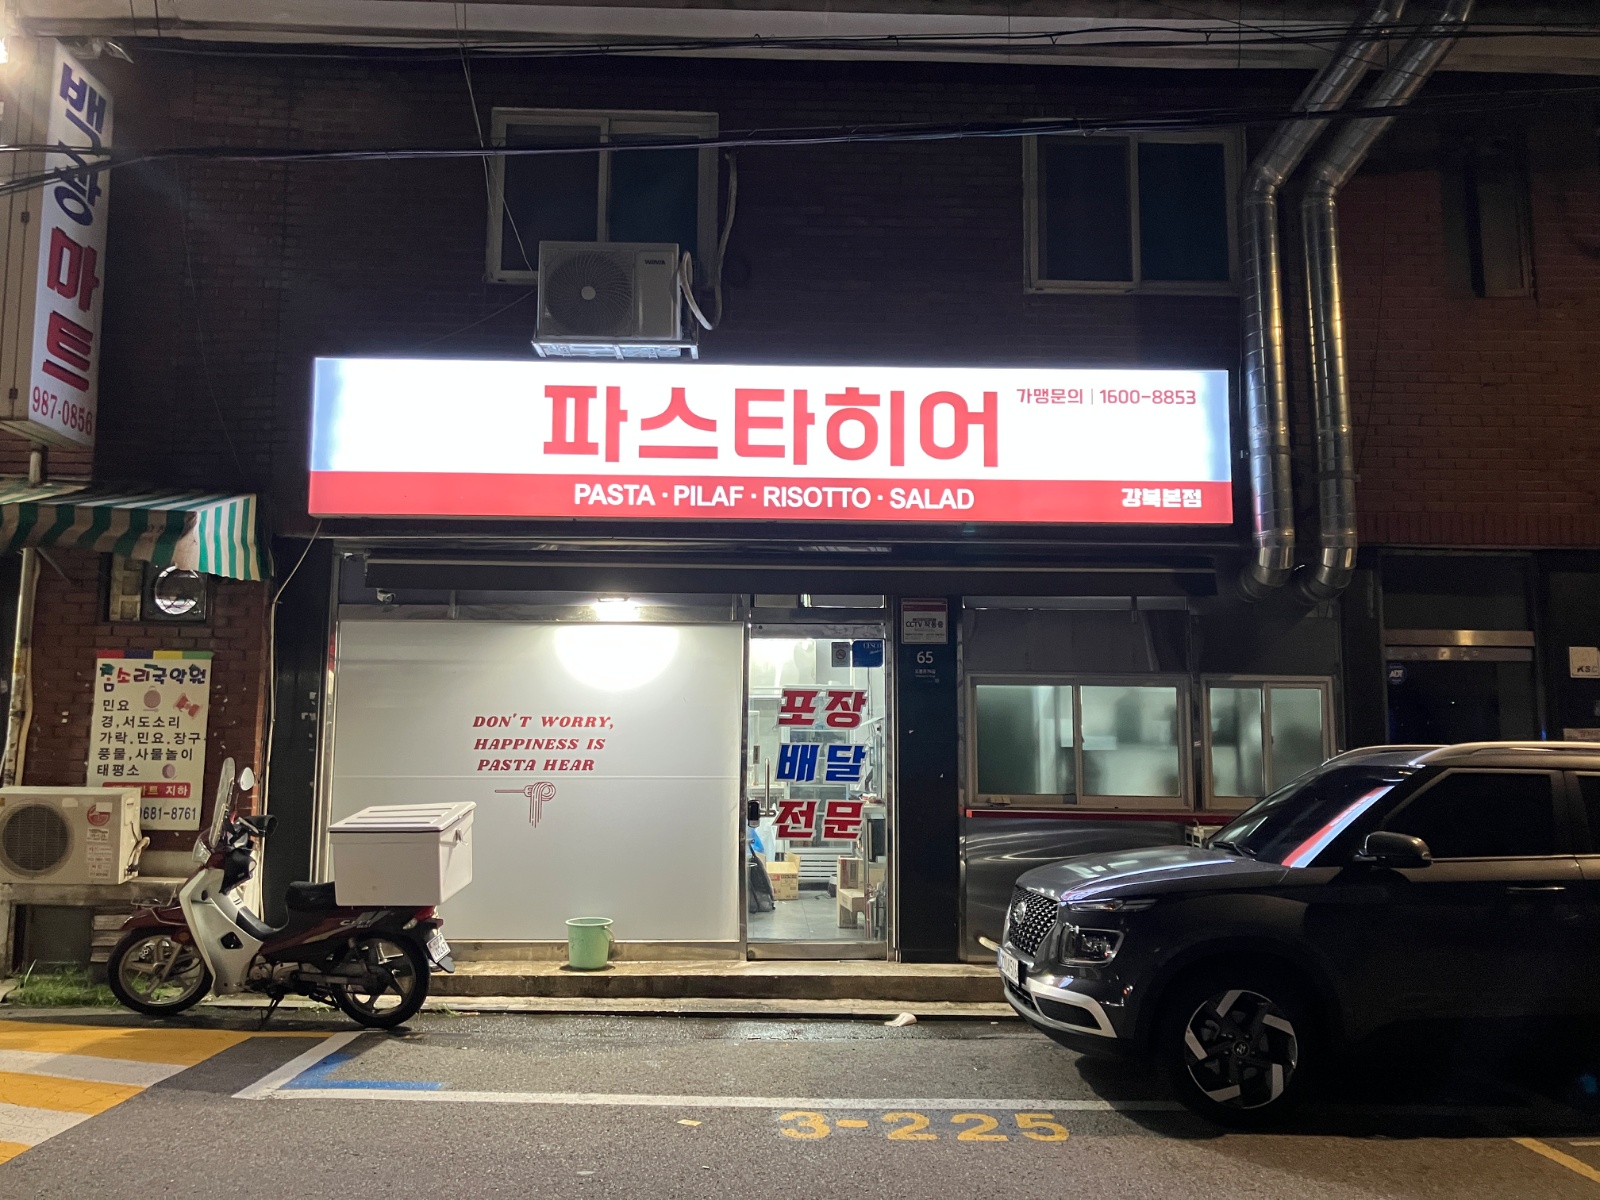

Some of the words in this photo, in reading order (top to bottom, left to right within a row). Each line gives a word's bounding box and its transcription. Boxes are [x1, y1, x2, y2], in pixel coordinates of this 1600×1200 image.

[1016, 388, 1084, 405] 가맹문의
[1099, 389, 1197, 405] 1600-8853
[32, 386, 94, 436] 987-0856
[543, 384, 998, 468] 파스타히어
[573, 482, 656, 506] PASTA
[673, 484, 745, 507] PILAF
[763, 486, 871, 509] RISOTTO
[889, 487, 976, 510] SALAD
[1121, 487, 1203, 508] 강북본점
[905, 620, 923, 628] CCTV
[916, 650, 934, 664] 65
[103, 699, 130, 712] 민요
[777, 689, 868, 729] 포장
[472, 713, 533, 728] DON'T
[541, 715, 614, 730] WORRY,
[473, 738, 580, 751] HAPPINESS
[586, 738, 606, 751] IS
[96, 763, 140, 777] 태평소
[477, 758, 537, 772] PASTA
[542, 758, 596, 772] HEAR
[775, 744, 867, 783] 배달
[165, 785, 189, 797] 지하
[140, 806, 197, 821] 681-8761
[774, 800, 864, 840] 전문
[778, 1110, 1070, 1142] 3-225
